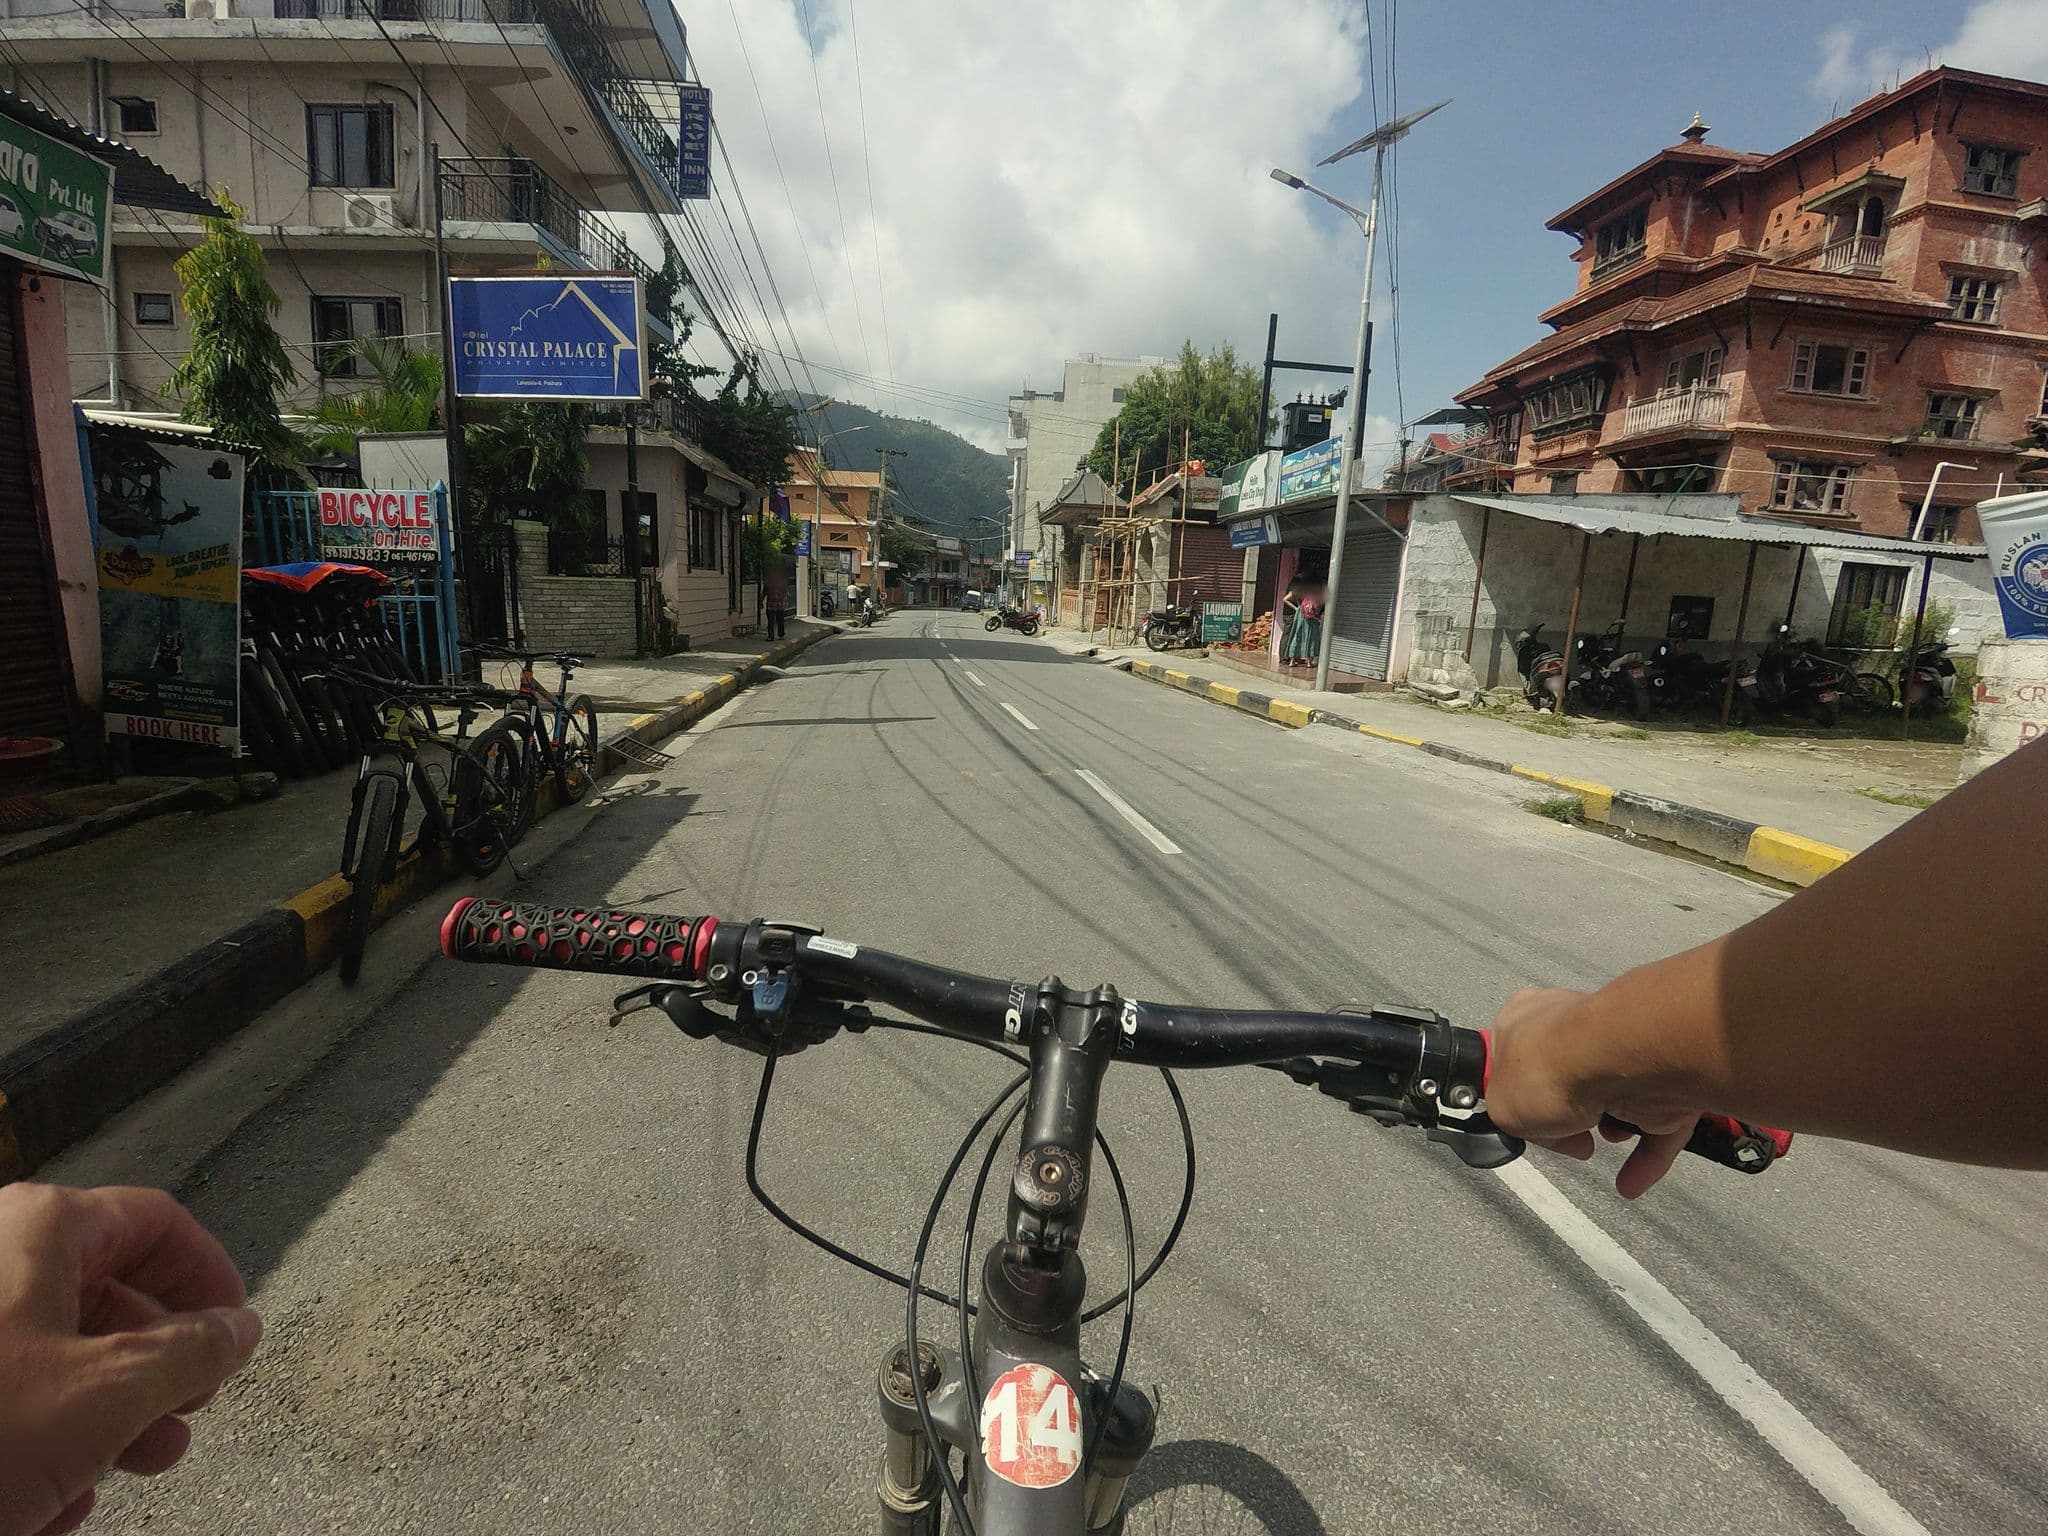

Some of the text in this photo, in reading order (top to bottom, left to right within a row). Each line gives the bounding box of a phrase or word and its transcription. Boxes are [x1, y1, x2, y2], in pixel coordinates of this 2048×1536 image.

[684, 164, 705, 175] INN
[463, 341, 608, 359] CRYSTAL PALACE
[466, 359, 607, 368] PRIVATE LIMITED
[321, 492, 431, 528] BICYCLE
[375, 529, 432, 548] On Hire
[2001, 532, 2041, 571] RUSLAN
[2006, 584, 2029, 607] 100%
[1206, 603, 1242, 616] LAUNDRY
[126, 716, 221, 744] BOOK HERE
[985, 1382, 1082, 1463] 14
